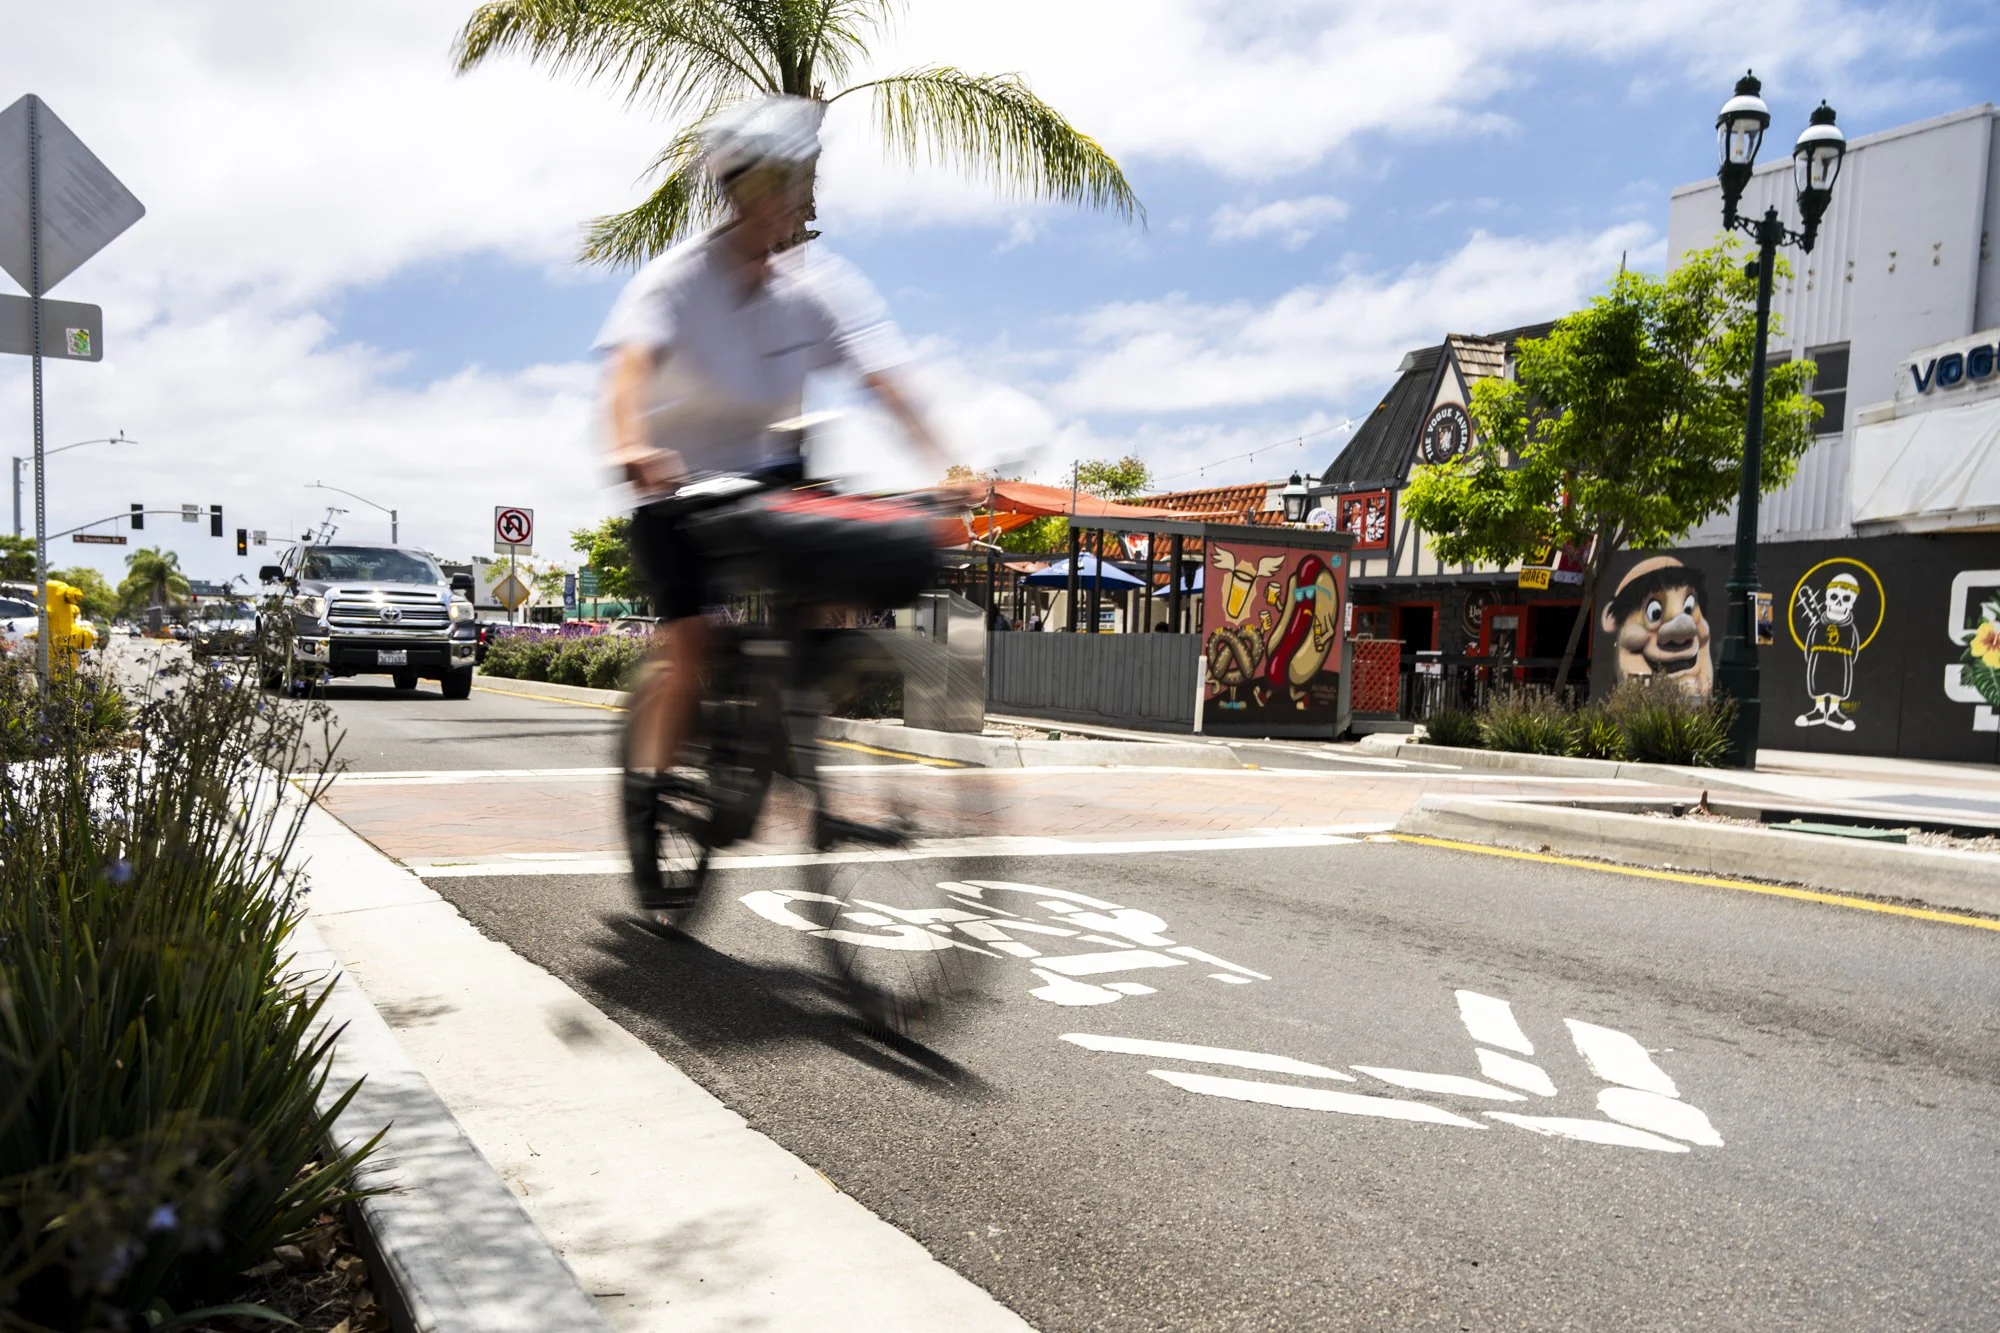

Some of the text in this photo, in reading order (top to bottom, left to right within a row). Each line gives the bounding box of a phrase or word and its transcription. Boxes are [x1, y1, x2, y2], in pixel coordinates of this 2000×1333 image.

[1911, 341, 2000, 393] VOG
[1425, 408, 1468, 460] THE VOGUE TAVERN
